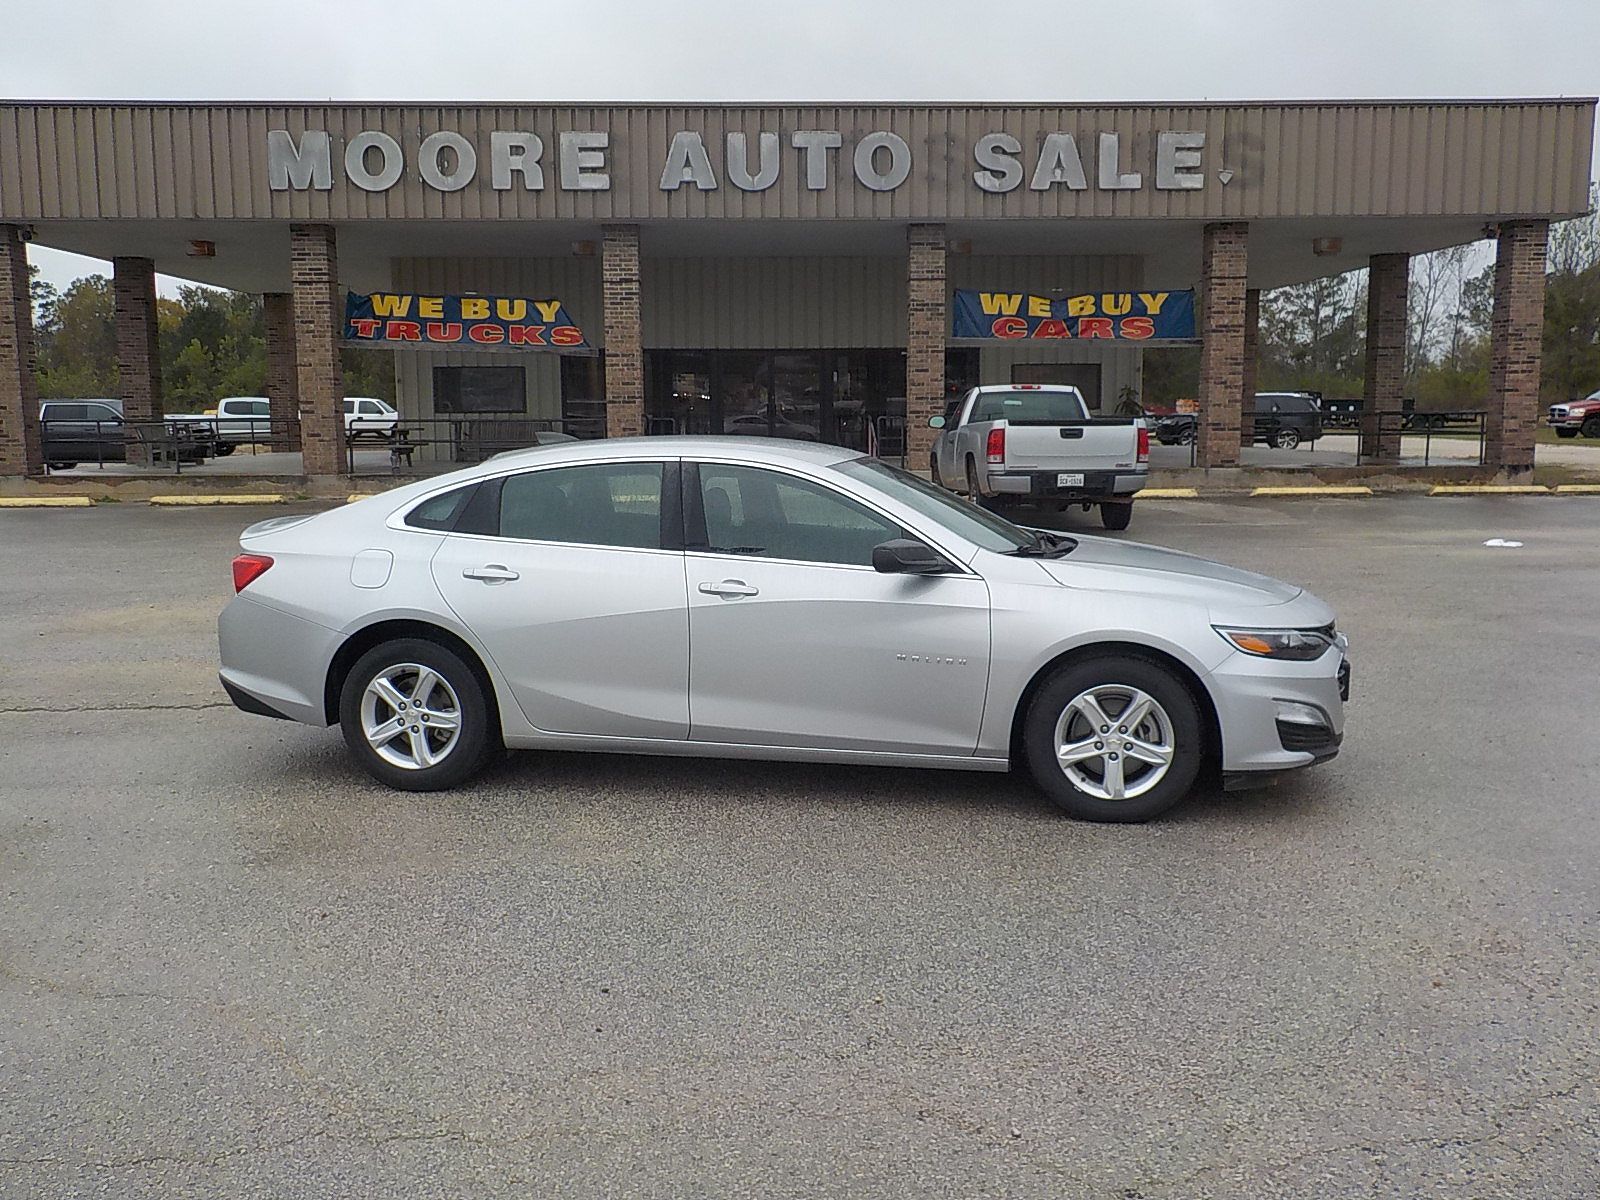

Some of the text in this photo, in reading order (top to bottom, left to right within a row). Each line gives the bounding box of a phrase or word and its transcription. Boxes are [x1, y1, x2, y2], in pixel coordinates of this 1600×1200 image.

[267, 129, 611, 192] MOORE
[659, 130, 912, 192] AUTO
[369, 294, 561, 323] WE BUY
[979, 292, 1170, 318] WE BUY
[350, 318, 584, 346] TRUCKS
[991, 316, 1156, 340] CARS
